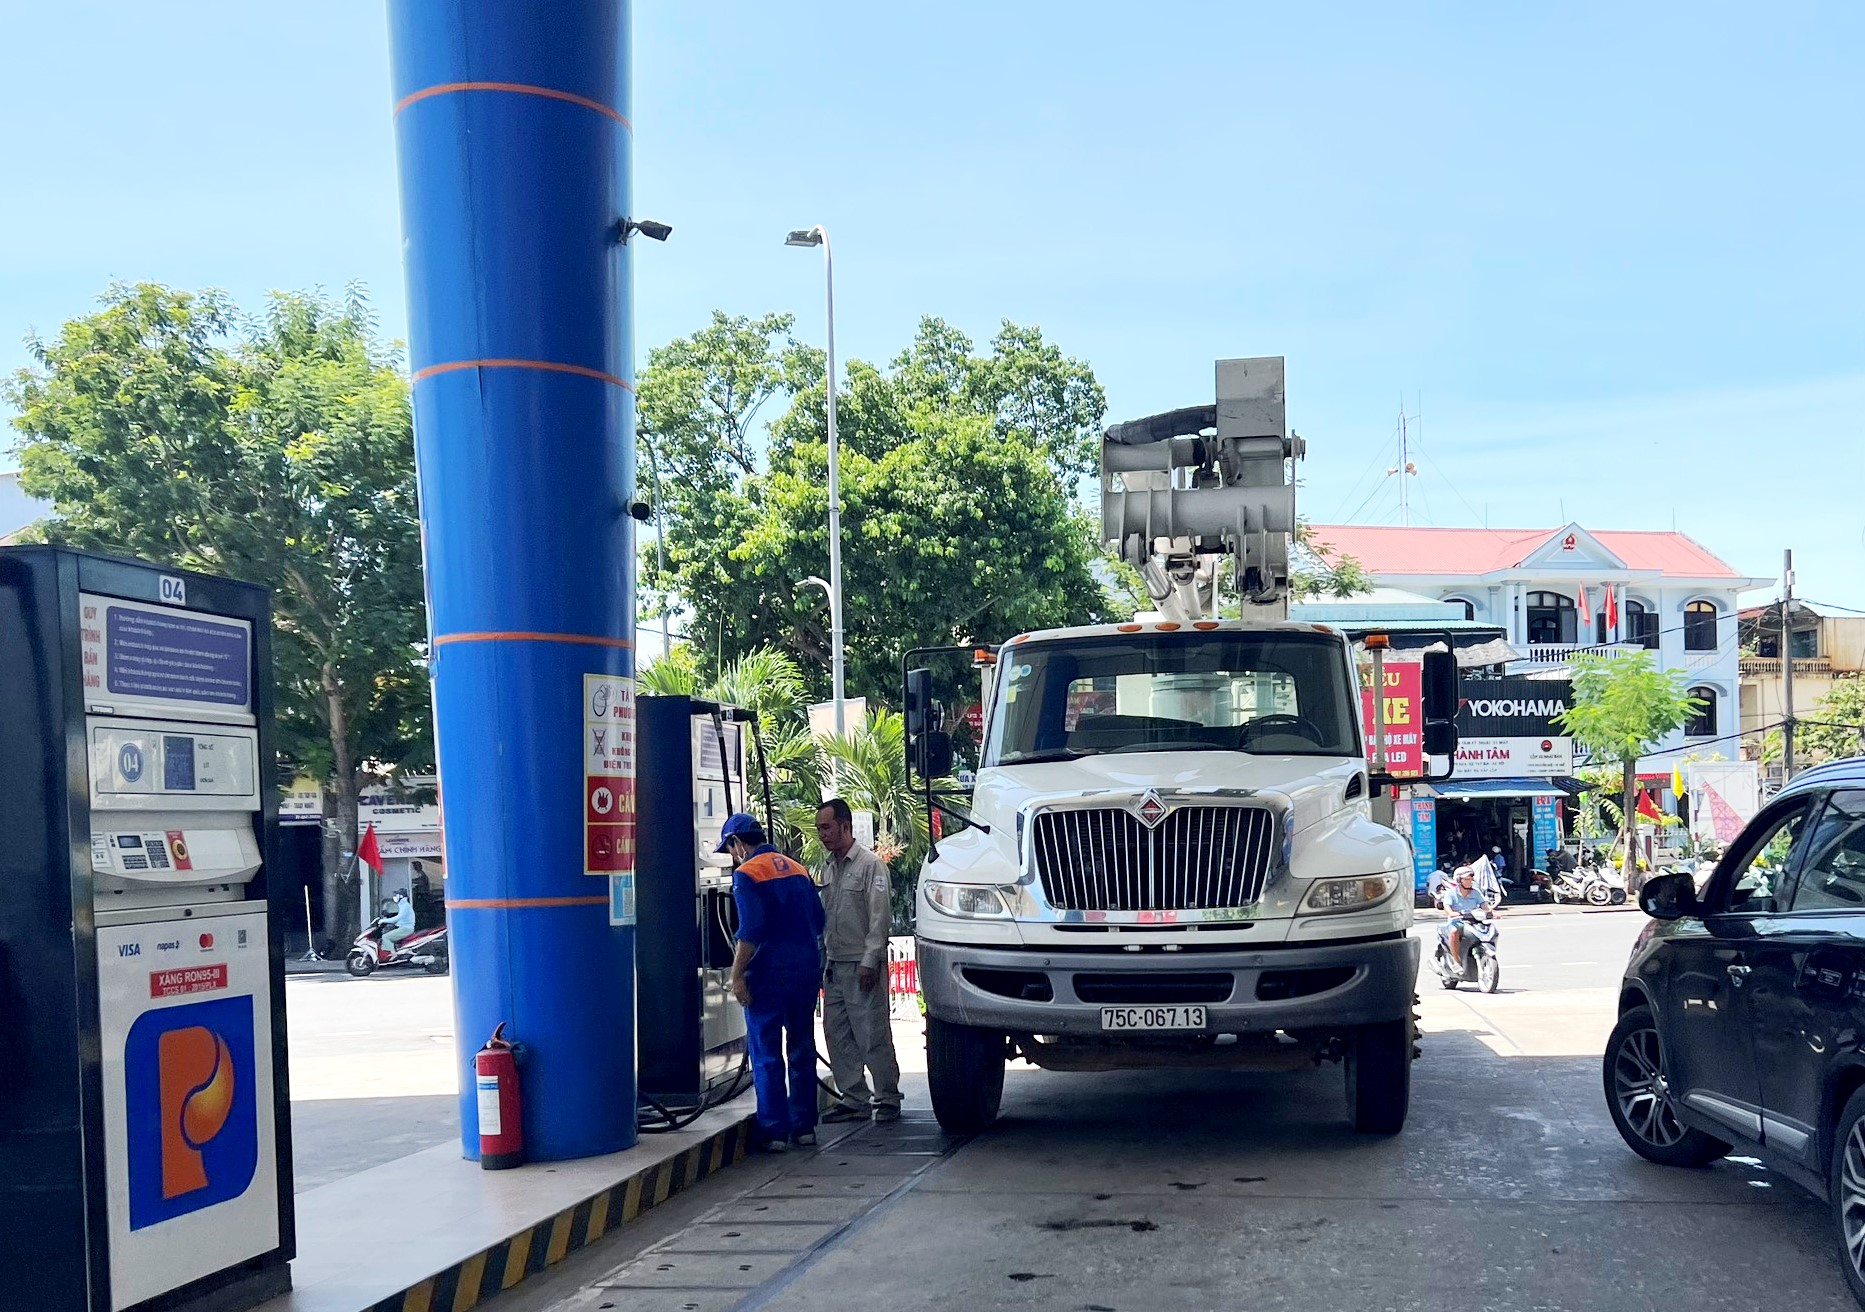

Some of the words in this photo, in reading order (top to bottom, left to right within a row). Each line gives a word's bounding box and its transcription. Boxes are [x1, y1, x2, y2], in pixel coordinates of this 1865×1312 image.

[162, 578, 183, 601] 04
[1468, 699, 1566, 717] YOKOHAMA
[1393, 734, 1402, 746] XE
[1391, 752, 1407, 763] LED
[1486, 746, 1509, 760] TÂM
[123, 752, 139, 773] 04
[372, 807, 421, 815] COSMETIC
[119, 943, 141, 957] VISA
[157, 941, 175, 952] napas
[162, 985, 179, 996] TCCS
